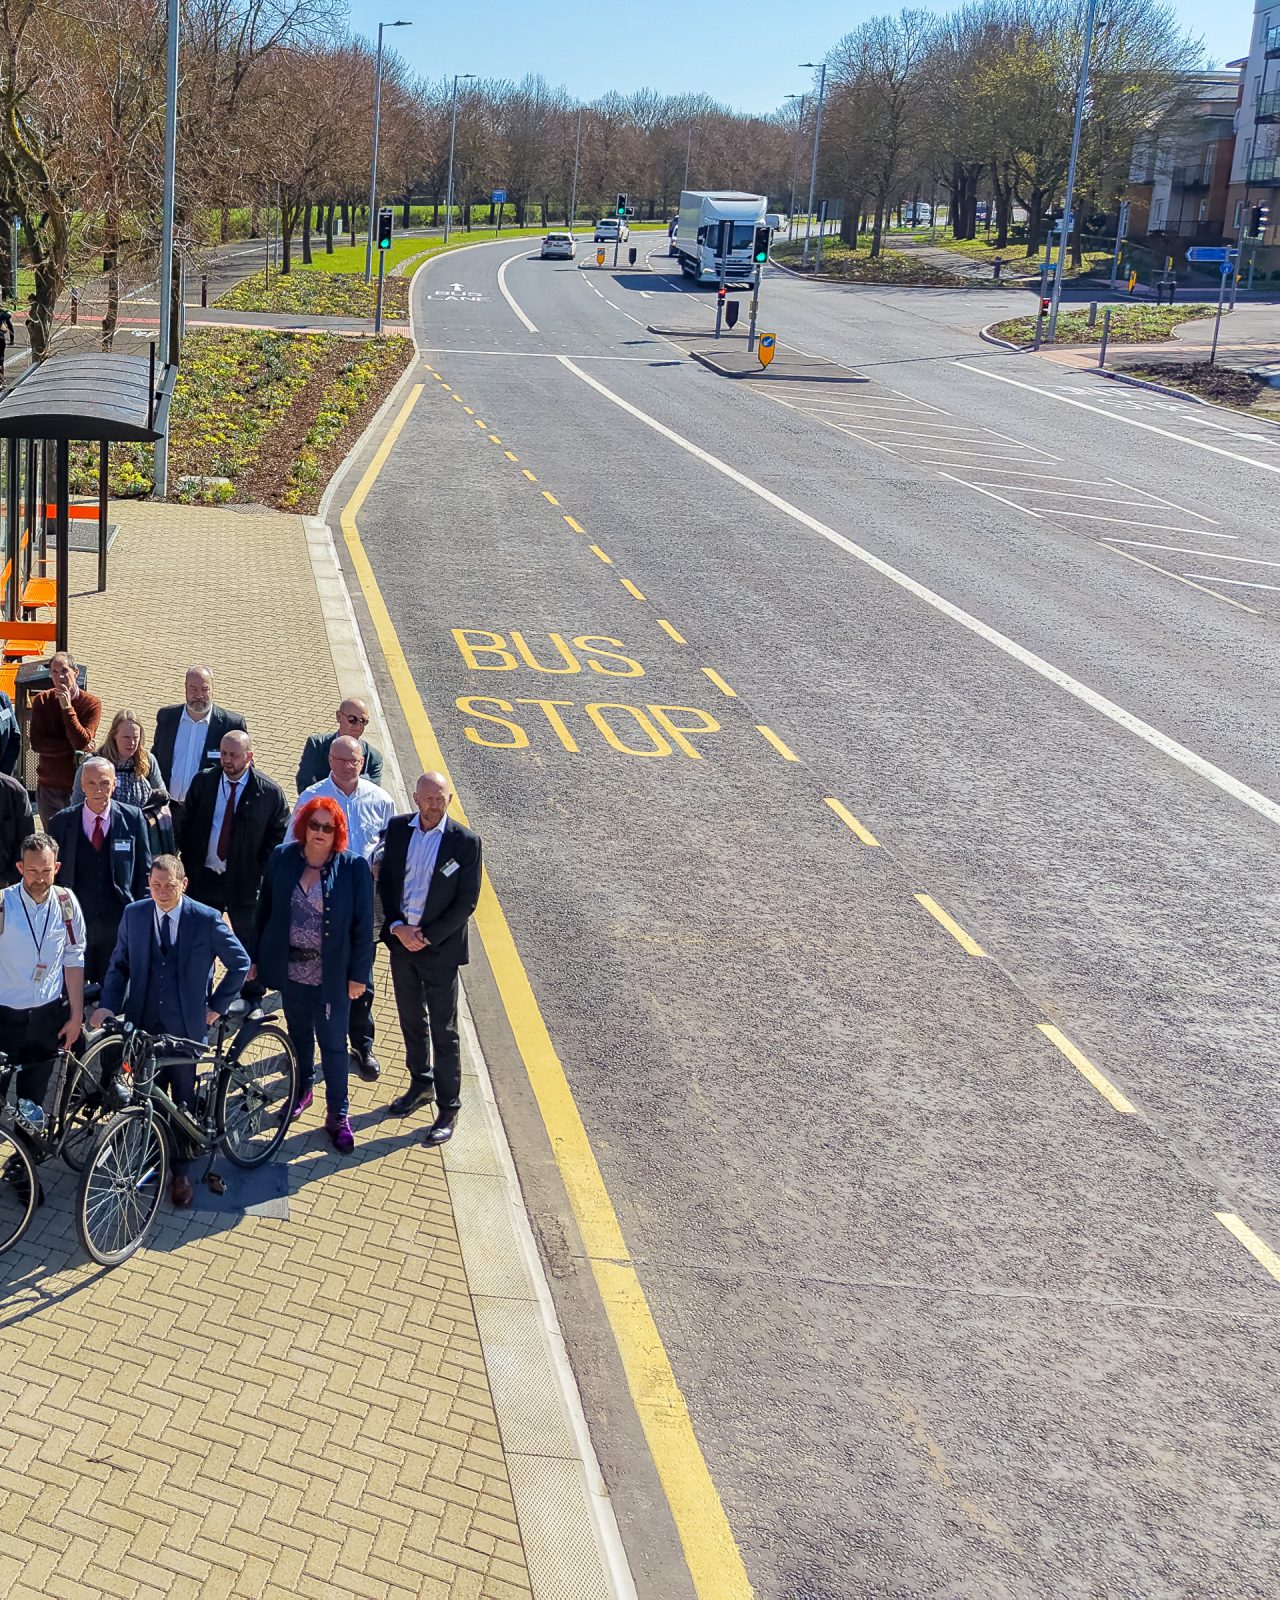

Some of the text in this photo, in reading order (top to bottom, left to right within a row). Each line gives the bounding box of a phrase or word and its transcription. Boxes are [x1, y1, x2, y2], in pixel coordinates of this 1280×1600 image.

[427, 295, 493, 303] LANE
[451, 629, 646, 677] BUS
[455, 696, 721, 760] STOP
